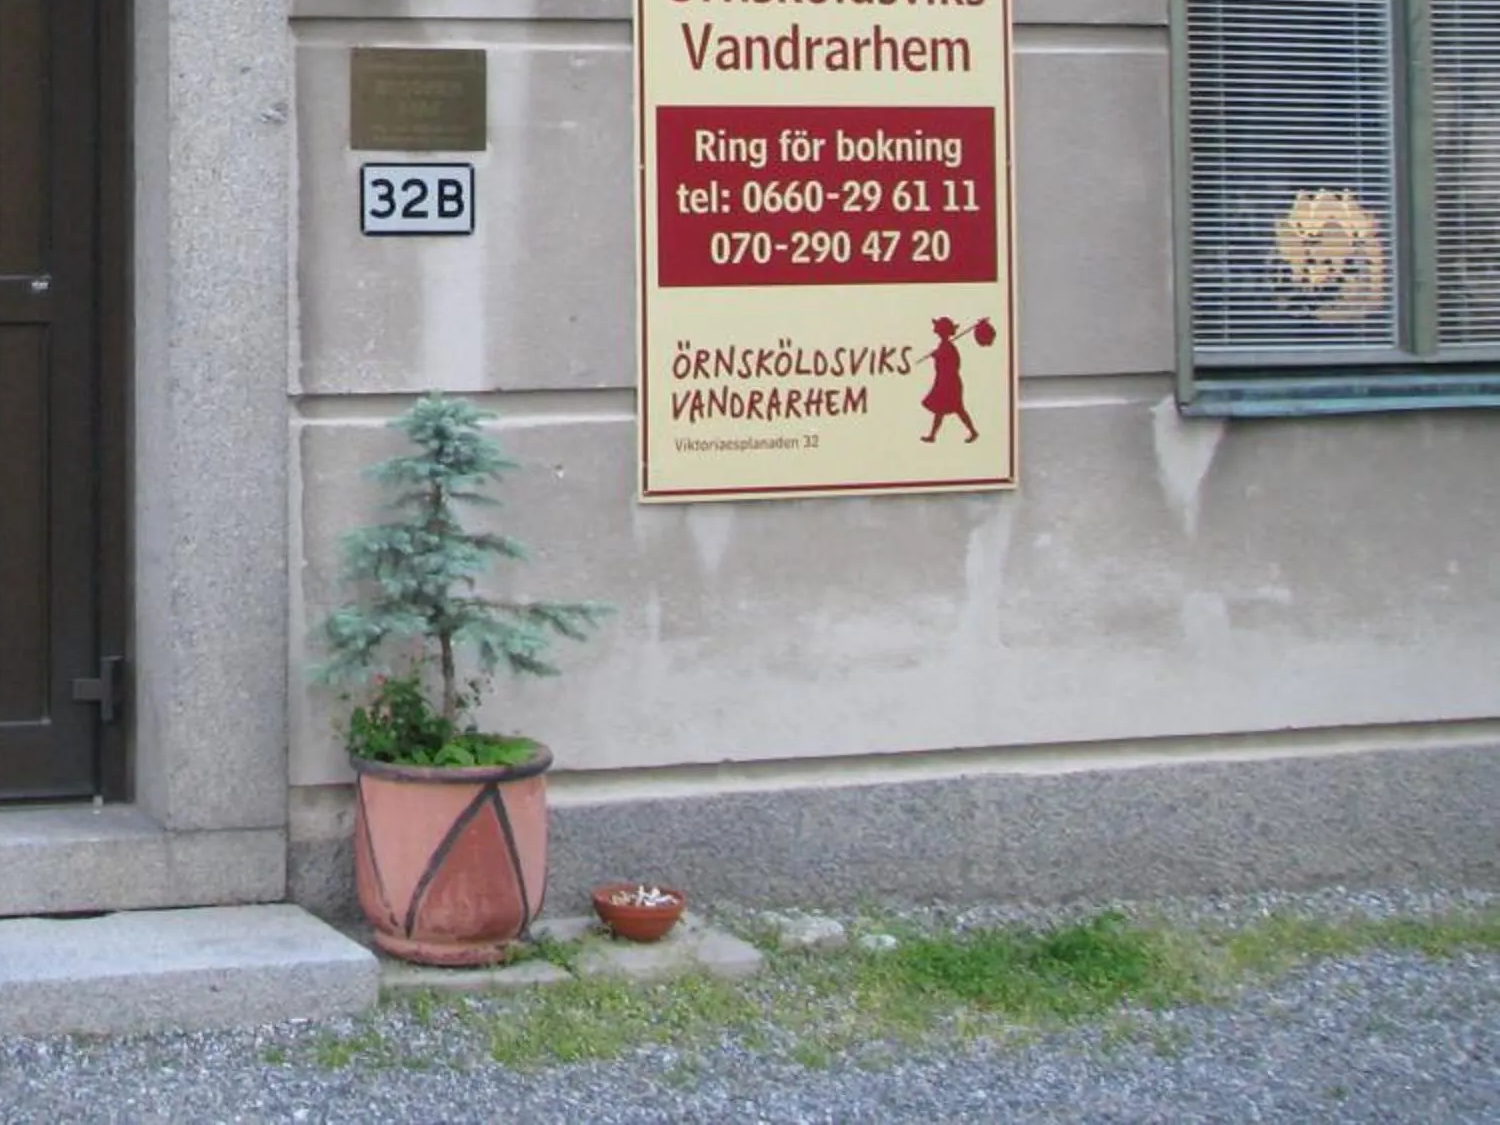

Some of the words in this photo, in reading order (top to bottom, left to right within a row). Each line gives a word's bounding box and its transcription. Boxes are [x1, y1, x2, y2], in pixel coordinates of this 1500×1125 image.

[681, 23, 971, 72] Vandrarhem
[695, 129, 768, 168] Ring
[778, 129, 825, 162] för
[837, 129, 962, 167] bokning
[369, 178, 465, 219] 32B
[676, 182, 731, 214] tel:
[742, 180, 882, 213] 0660-29
[893, 180, 930, 212] 61
[943, 179, 980, 212] 11
[710, 231, 851, 264] 070-290
[861, 231, 901, 262] 47
[911, 230, 951, 262] 20
[672, 339, 913, 379] ÖRNSKÖLDSVIKS
[671, 385, 868, 422] VANDRARHEM
[803, 434, 820, 448] 32
